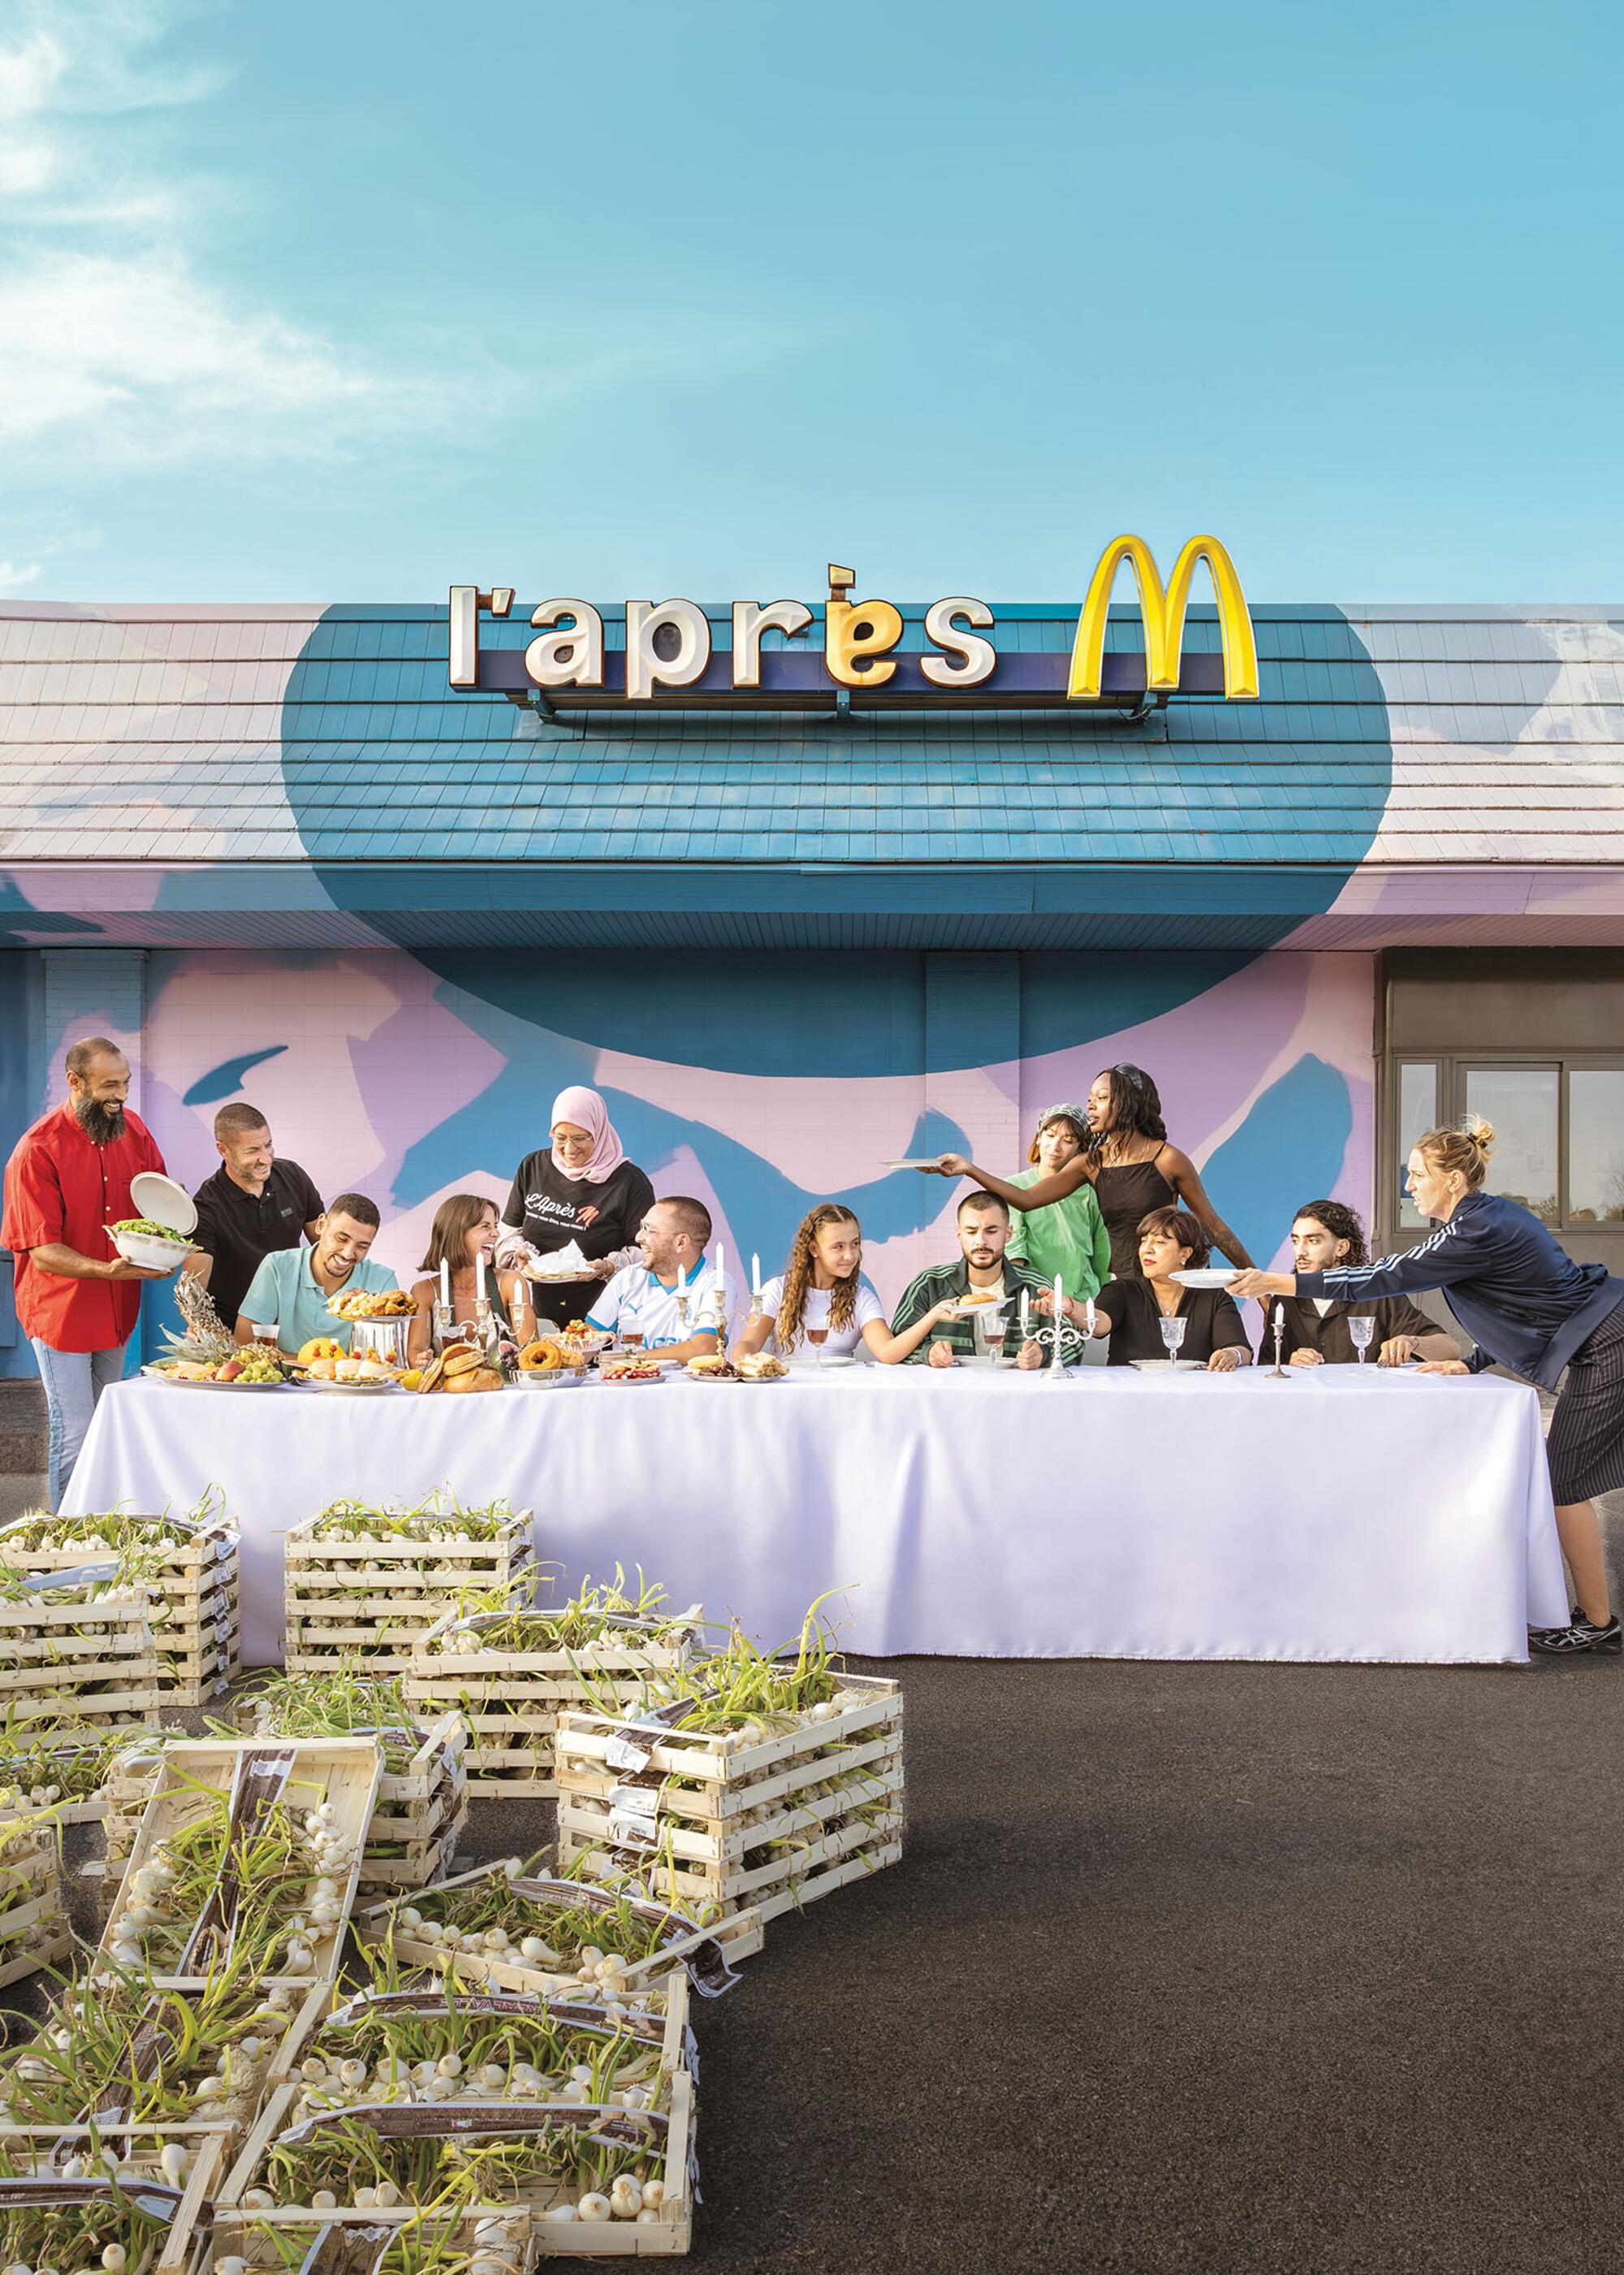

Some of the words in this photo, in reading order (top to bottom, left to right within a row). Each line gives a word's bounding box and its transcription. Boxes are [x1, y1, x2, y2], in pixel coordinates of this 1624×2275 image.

[449, 563, 997, 701] l'après
[1066, 534, 1260, 701] M
[525, 1193, 576, 1218] L'Après
[575, 1205, 599, 1227] M
